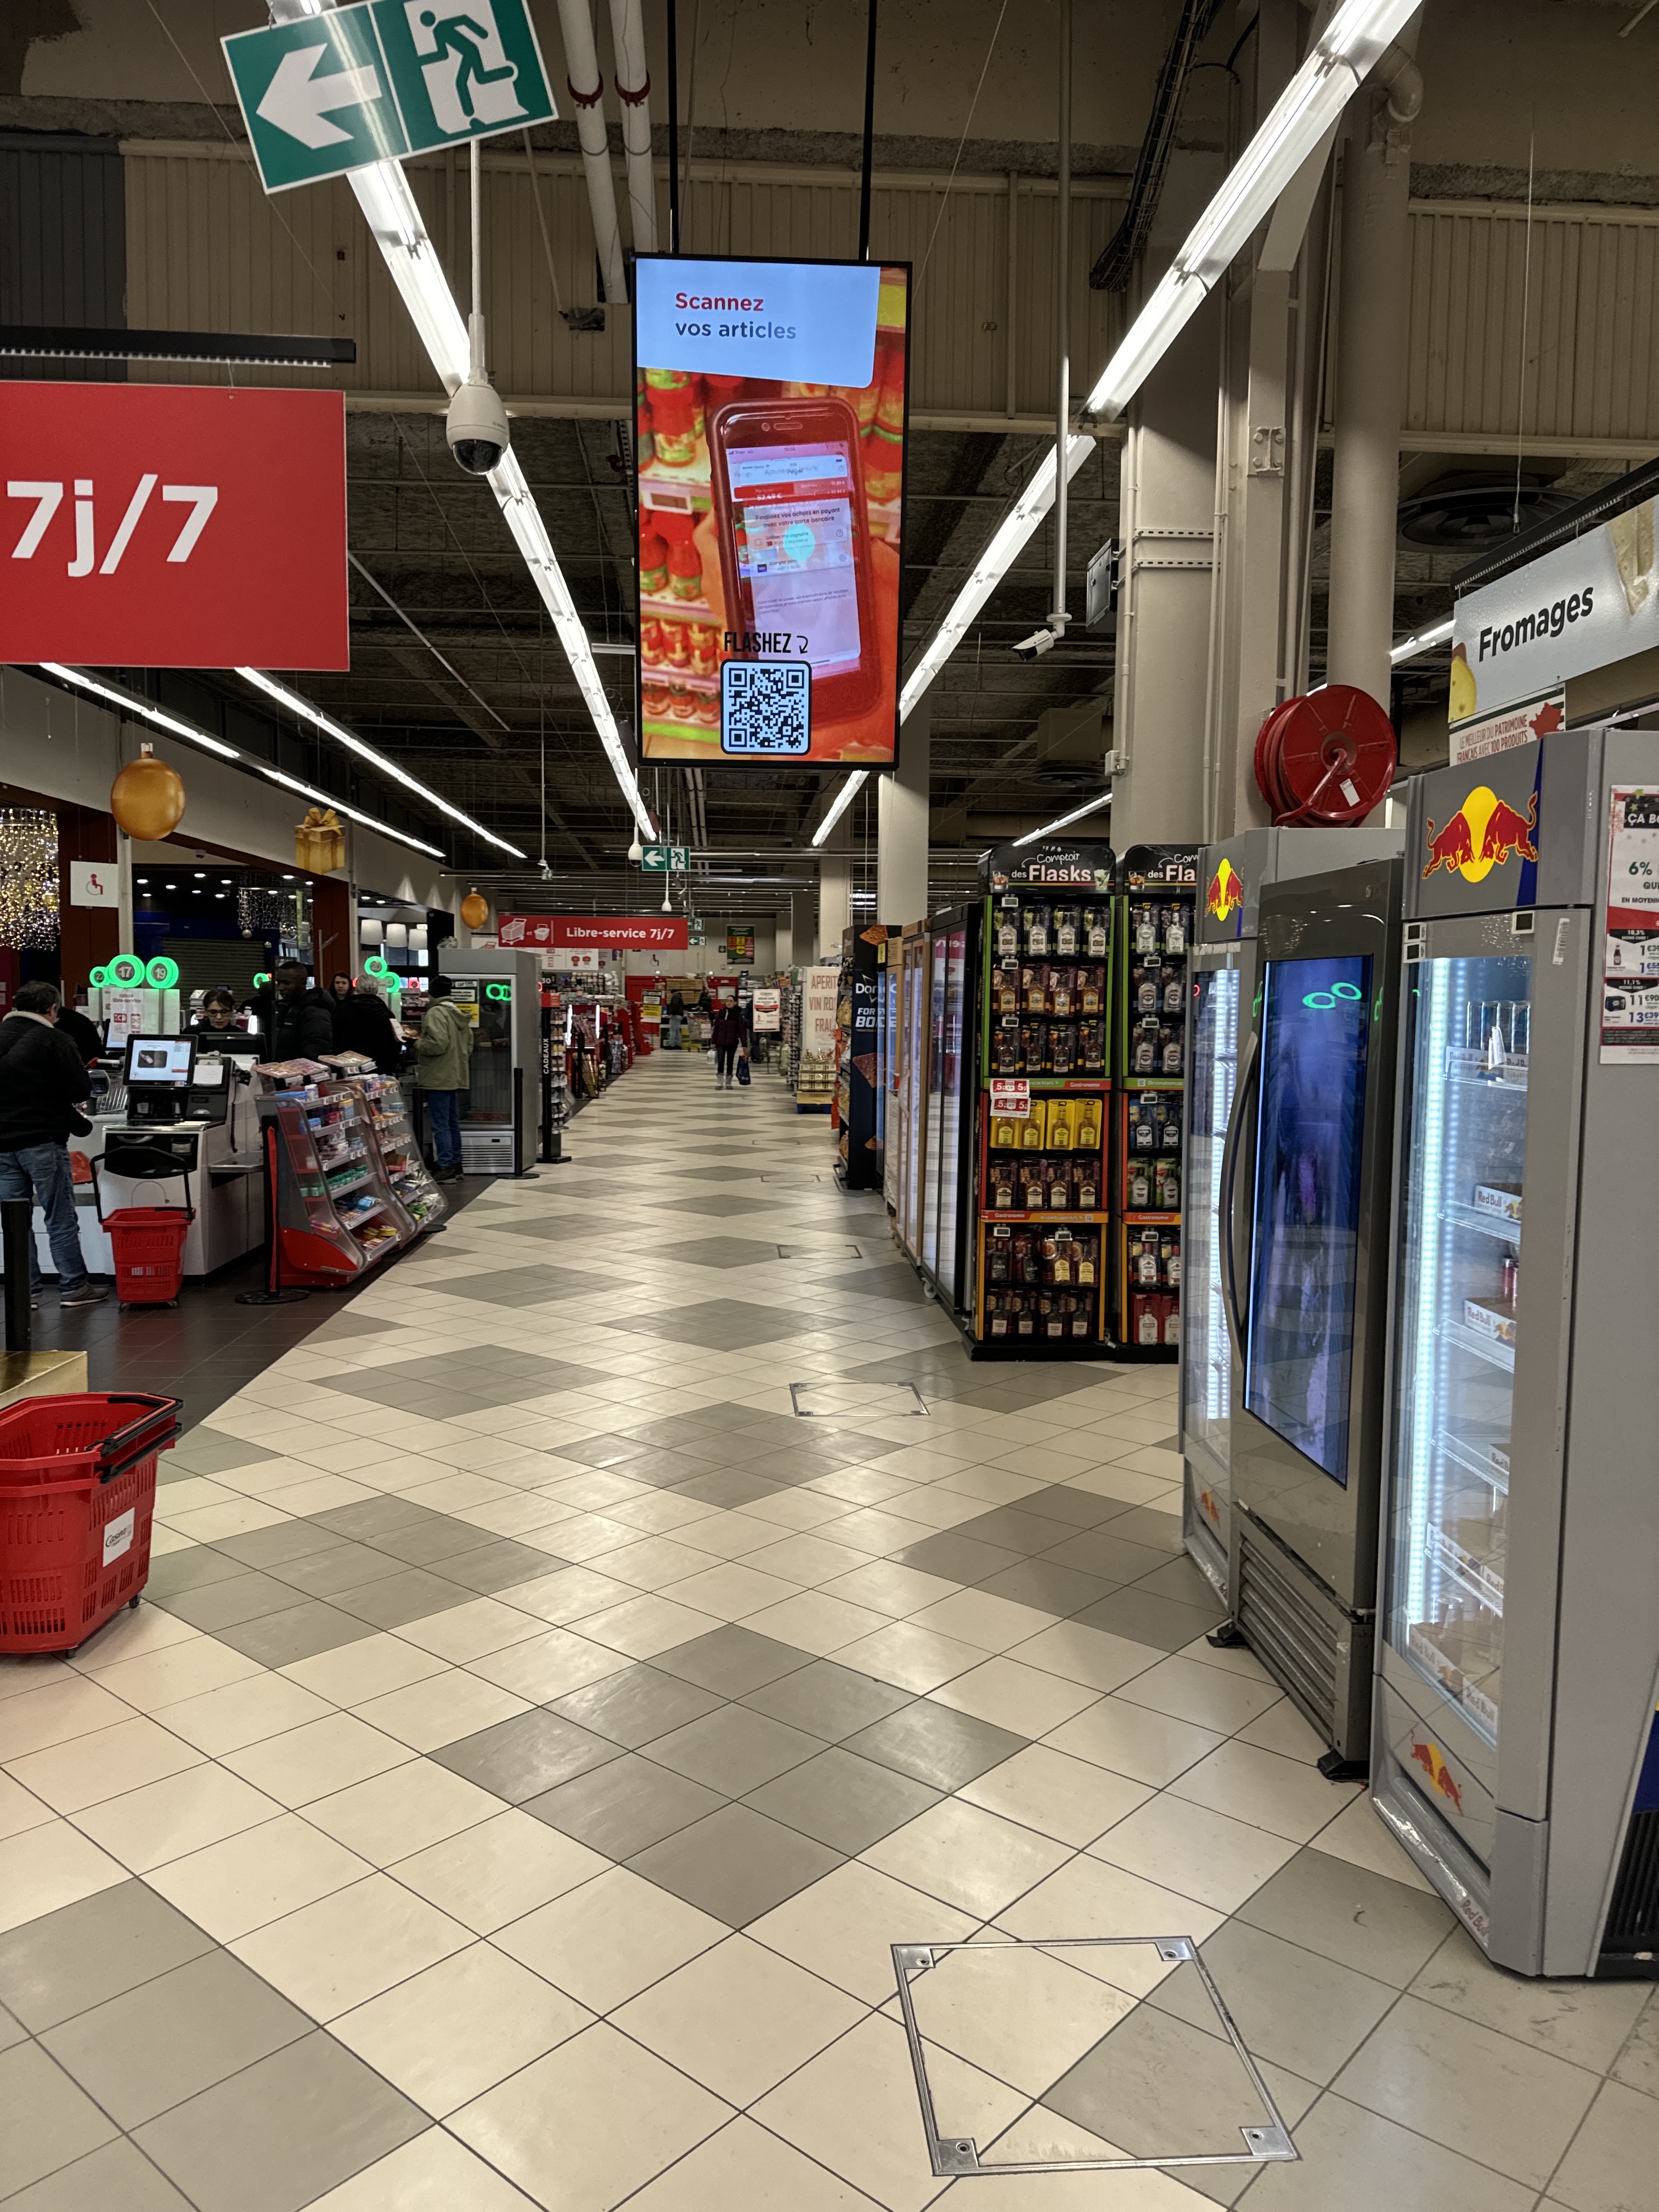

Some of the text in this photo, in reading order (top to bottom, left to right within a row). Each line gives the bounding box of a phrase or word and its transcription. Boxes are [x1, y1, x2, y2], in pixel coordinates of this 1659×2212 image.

[676, 292, 764, 311] Scannez
[675, 321, 796, 339] vos articles
[821, 507, 840, 516] payant
[7, 473, 218, 577] 7j/7
[1479, 587, 1594, 663] Fromages
[724, 631, 792, 653] FLASHEZ
[1460, 714, 1528, 749] LE MEILLEUR DU PATRIMOINE
[1479, 741, 1490, 757] AVEC
[1491, 738, 1500, 753] 100
[1501, 730, 1528, 751] PRODUITS
[1628, 813, 1645, 826] ÇA
[1037, 851, 1080, 865] Comptoir
[1029, 865, 1091, 881] Flasks
[1148, 870, 1163, 878] des
[1629, 861, 1652, 876] 6%
[567, 927, 646, 938] Libre-service
[650, 928, 675, 940] 7j/7
[119, 966, 132, 978] 17
[155, 968, 166, 979] 19
[809, 997, 821, 1011] VIN
[855, 1016, 877, 1028] BO
[1479, 1191, 1502, 1207] Red Bull
[1468, 1307, 1491, 1326] Red Bull
[1460, 1899, 1480, 1920] Red
